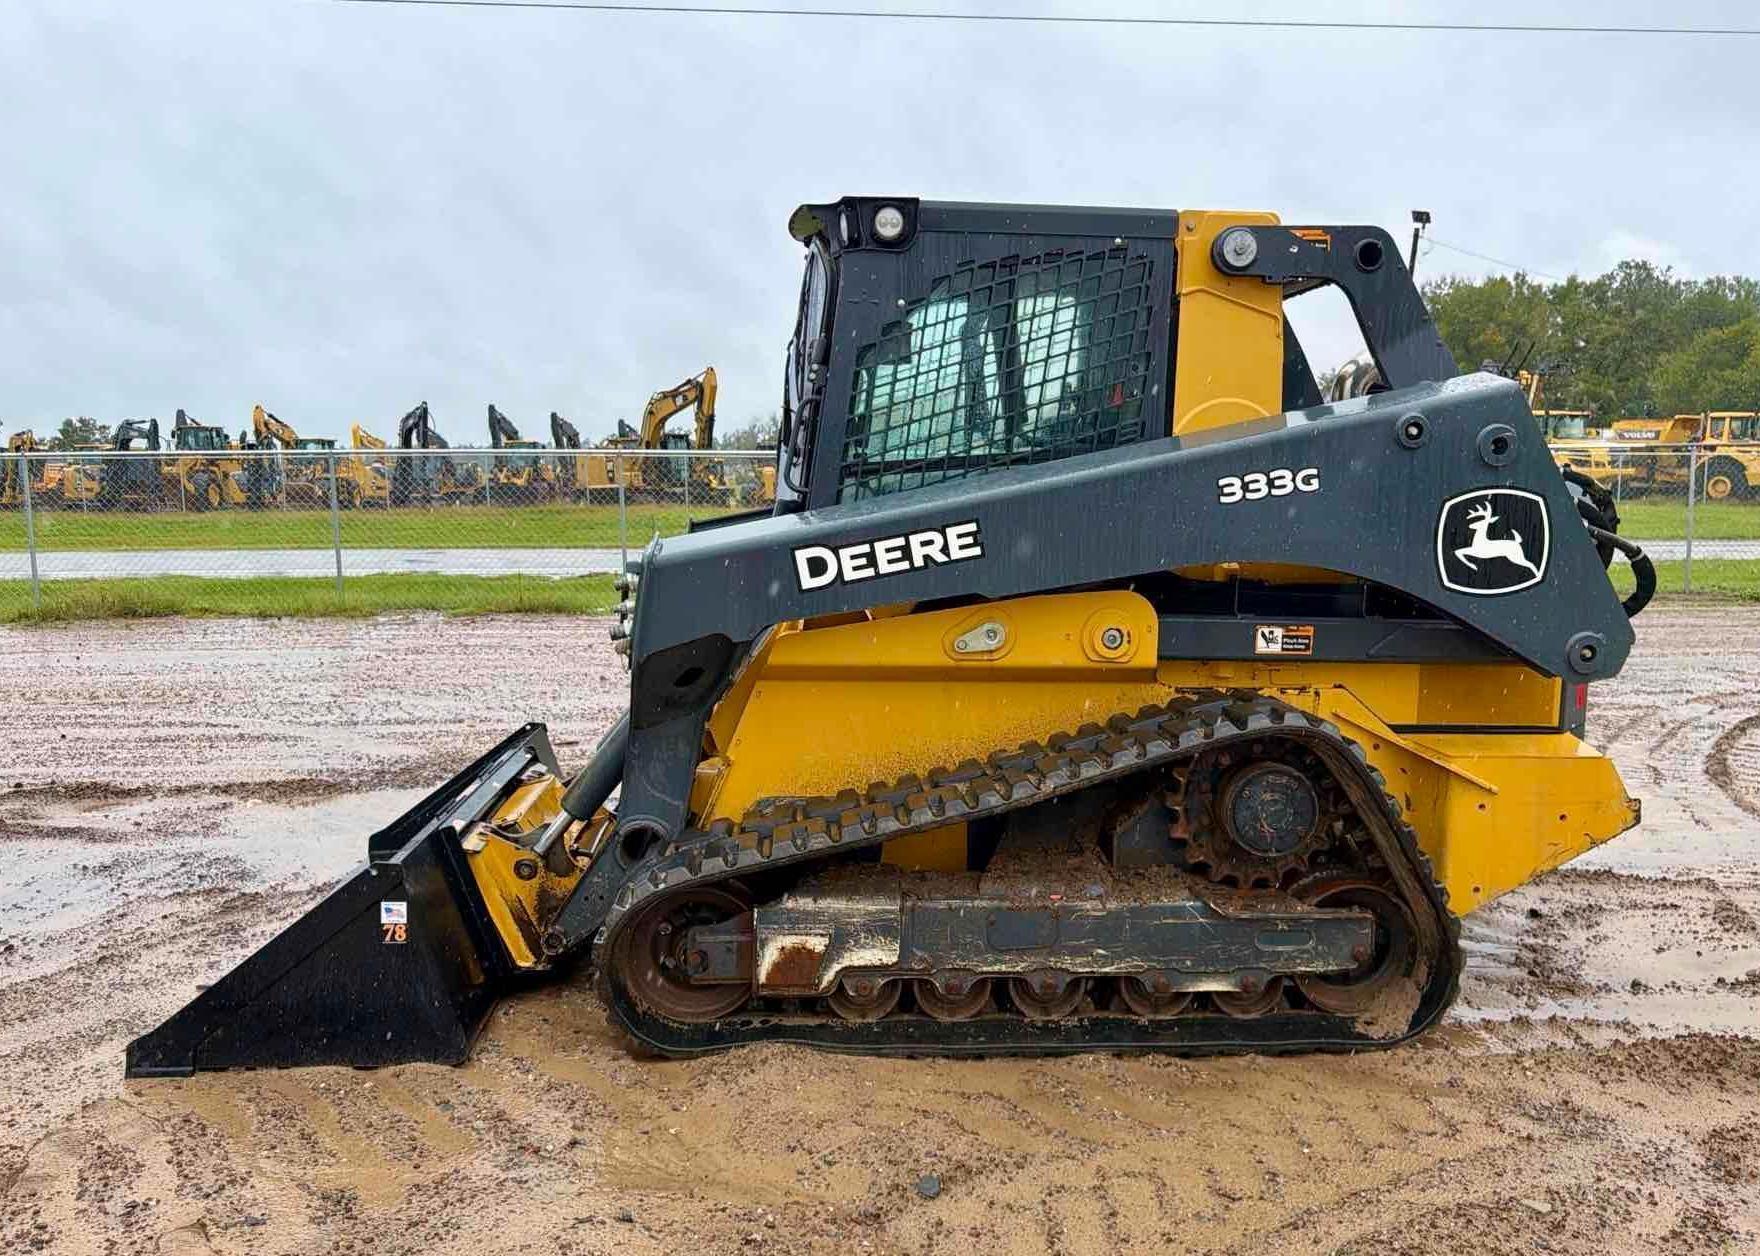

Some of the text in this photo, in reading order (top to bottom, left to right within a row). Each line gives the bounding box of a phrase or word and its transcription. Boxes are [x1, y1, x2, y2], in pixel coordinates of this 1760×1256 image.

[1218, 468, 1320, 504] 333G
[794, 522, 982, 590] DEERE
[382, 924, 407, 942] 78
